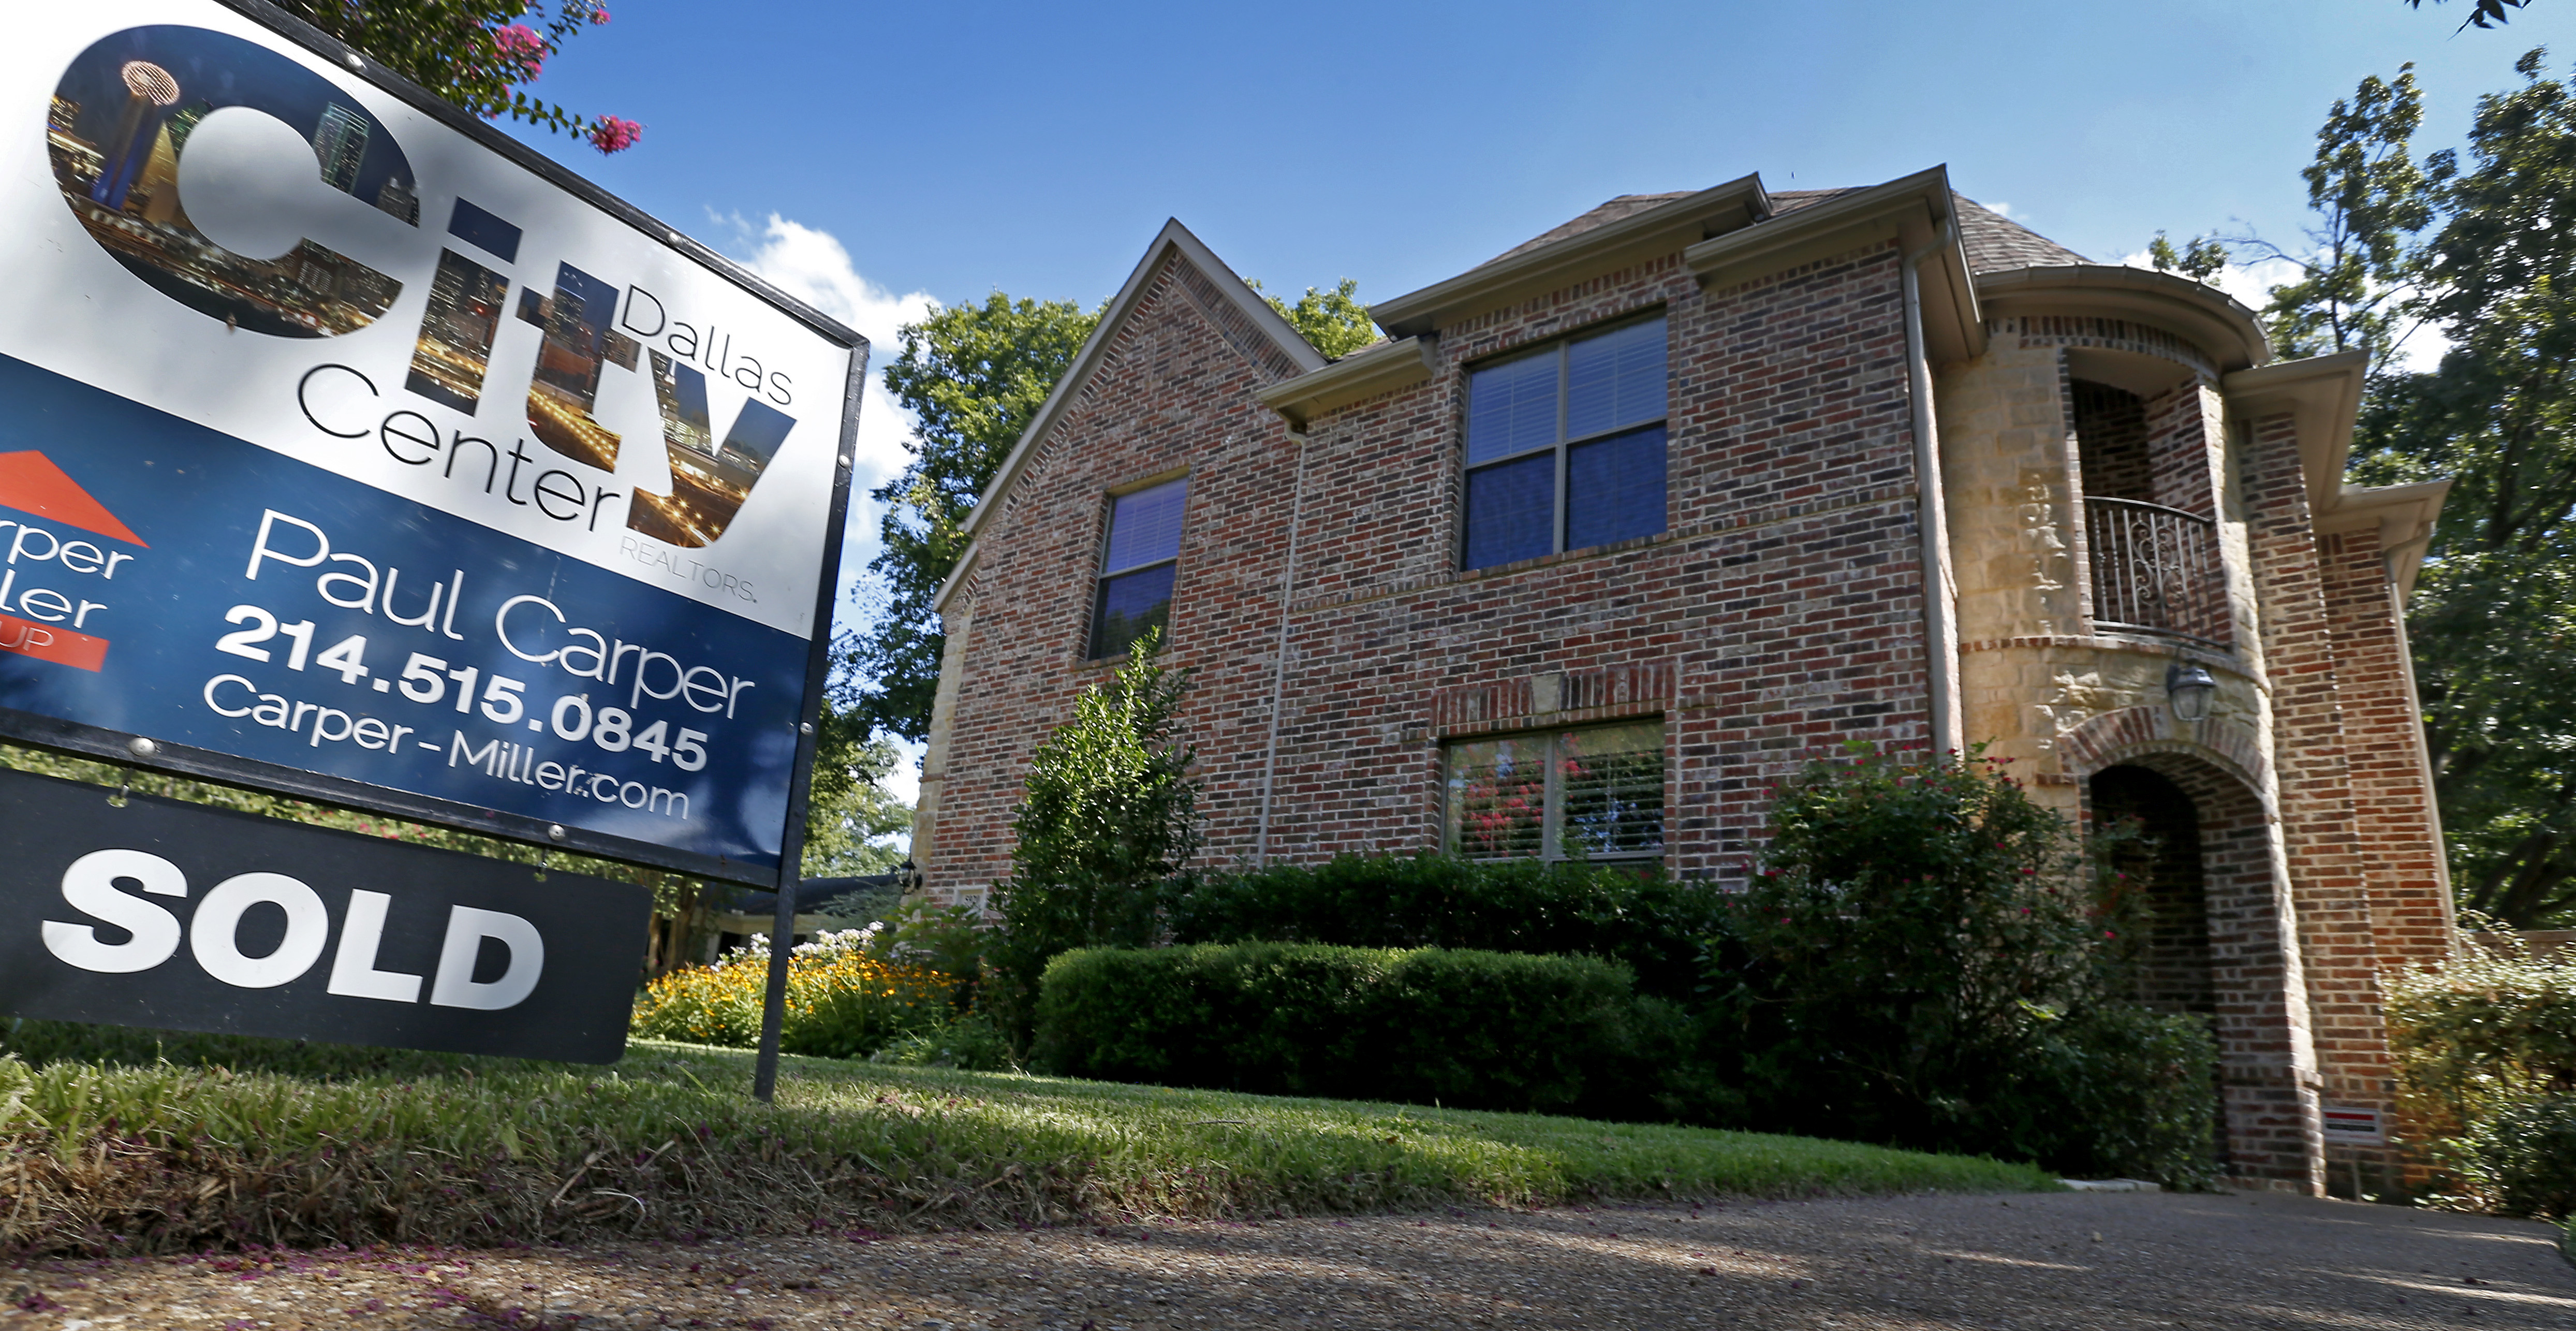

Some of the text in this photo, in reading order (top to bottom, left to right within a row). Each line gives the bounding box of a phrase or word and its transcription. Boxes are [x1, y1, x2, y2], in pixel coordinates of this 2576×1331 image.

[47, 24, 797, 548] City
[621, 283, 792, 405] Dallas
[298, 363, 621, 532] Center
[215, 604, 709, 772] 214.515.0845
[245, 508, 756, 720] Paul Carper
[42, 848, 544, 1011] SOLD
